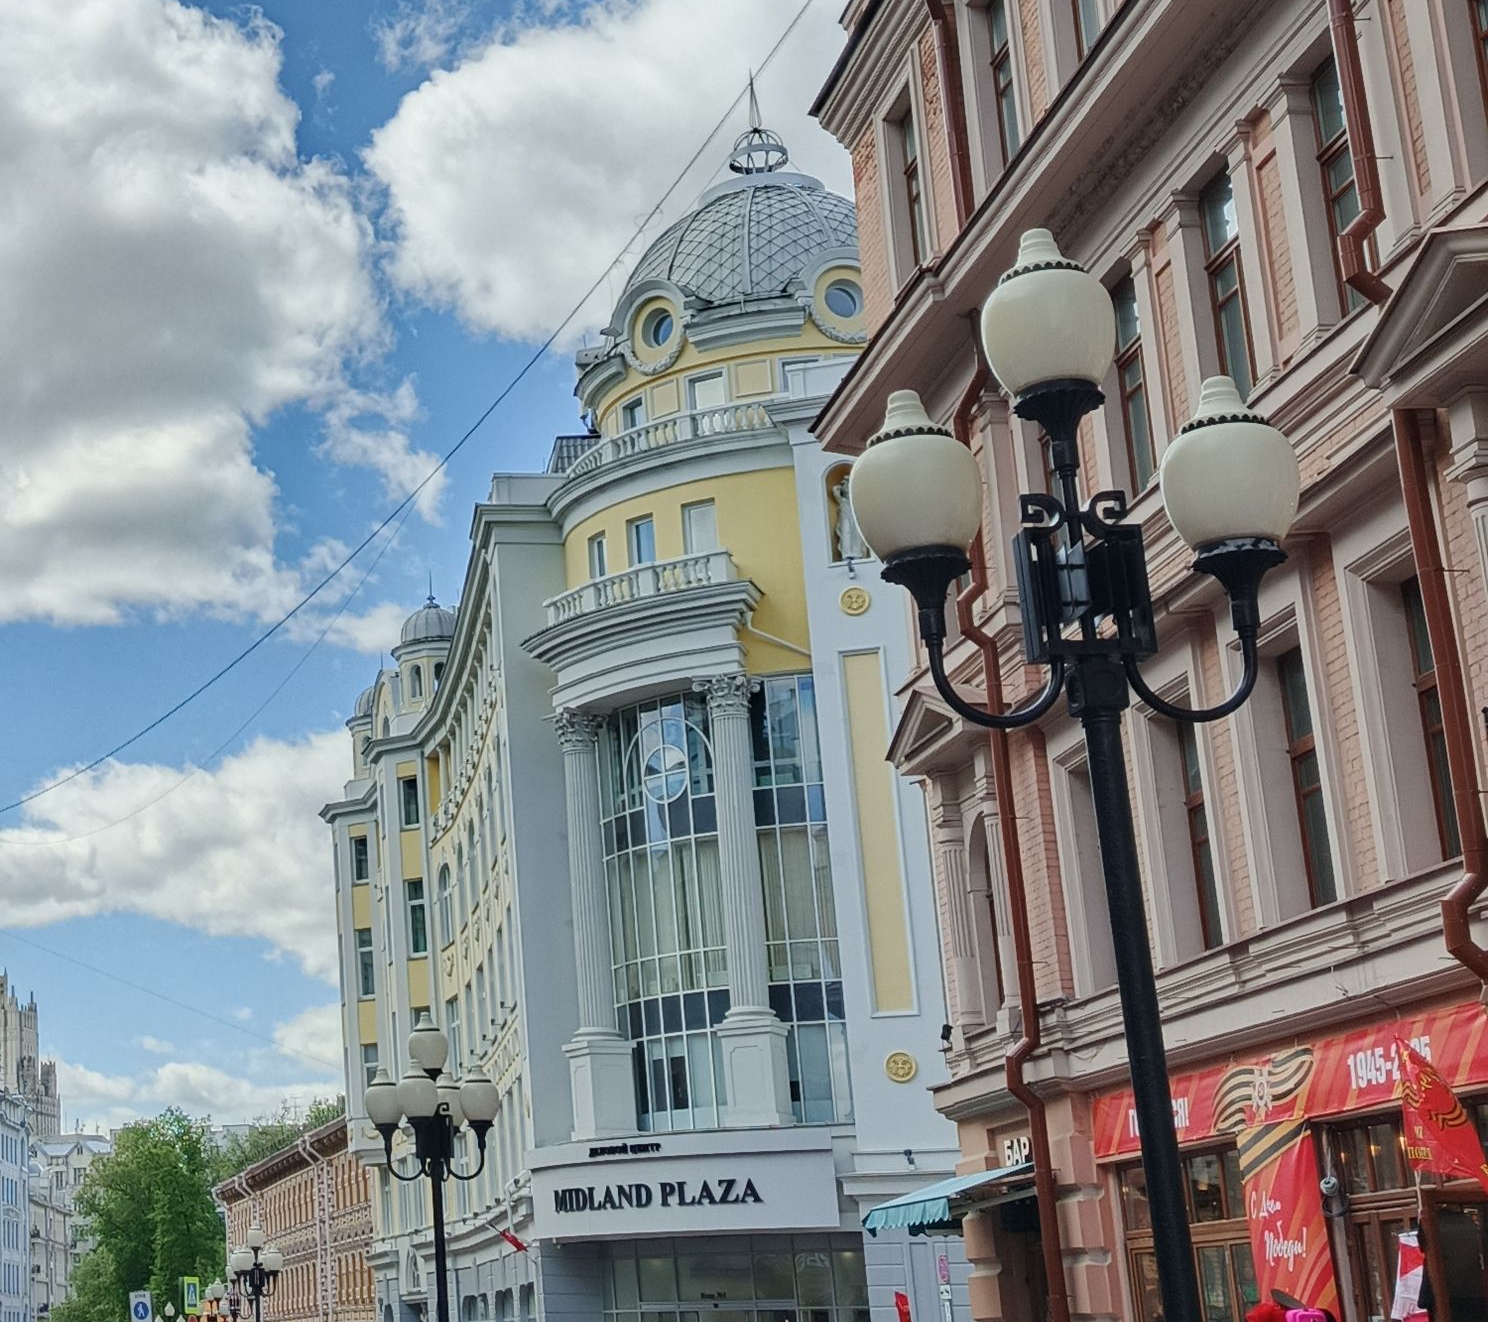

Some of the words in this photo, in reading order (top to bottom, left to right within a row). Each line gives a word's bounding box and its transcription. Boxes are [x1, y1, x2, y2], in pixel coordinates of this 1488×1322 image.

[1004, 1137, 1030, 1167] БАР
[554, 1183, 652, 1213] MIDLAND
[659, 1178, 763, 1207] PLAZA
[1251, 1190, 1257, 1220] С
